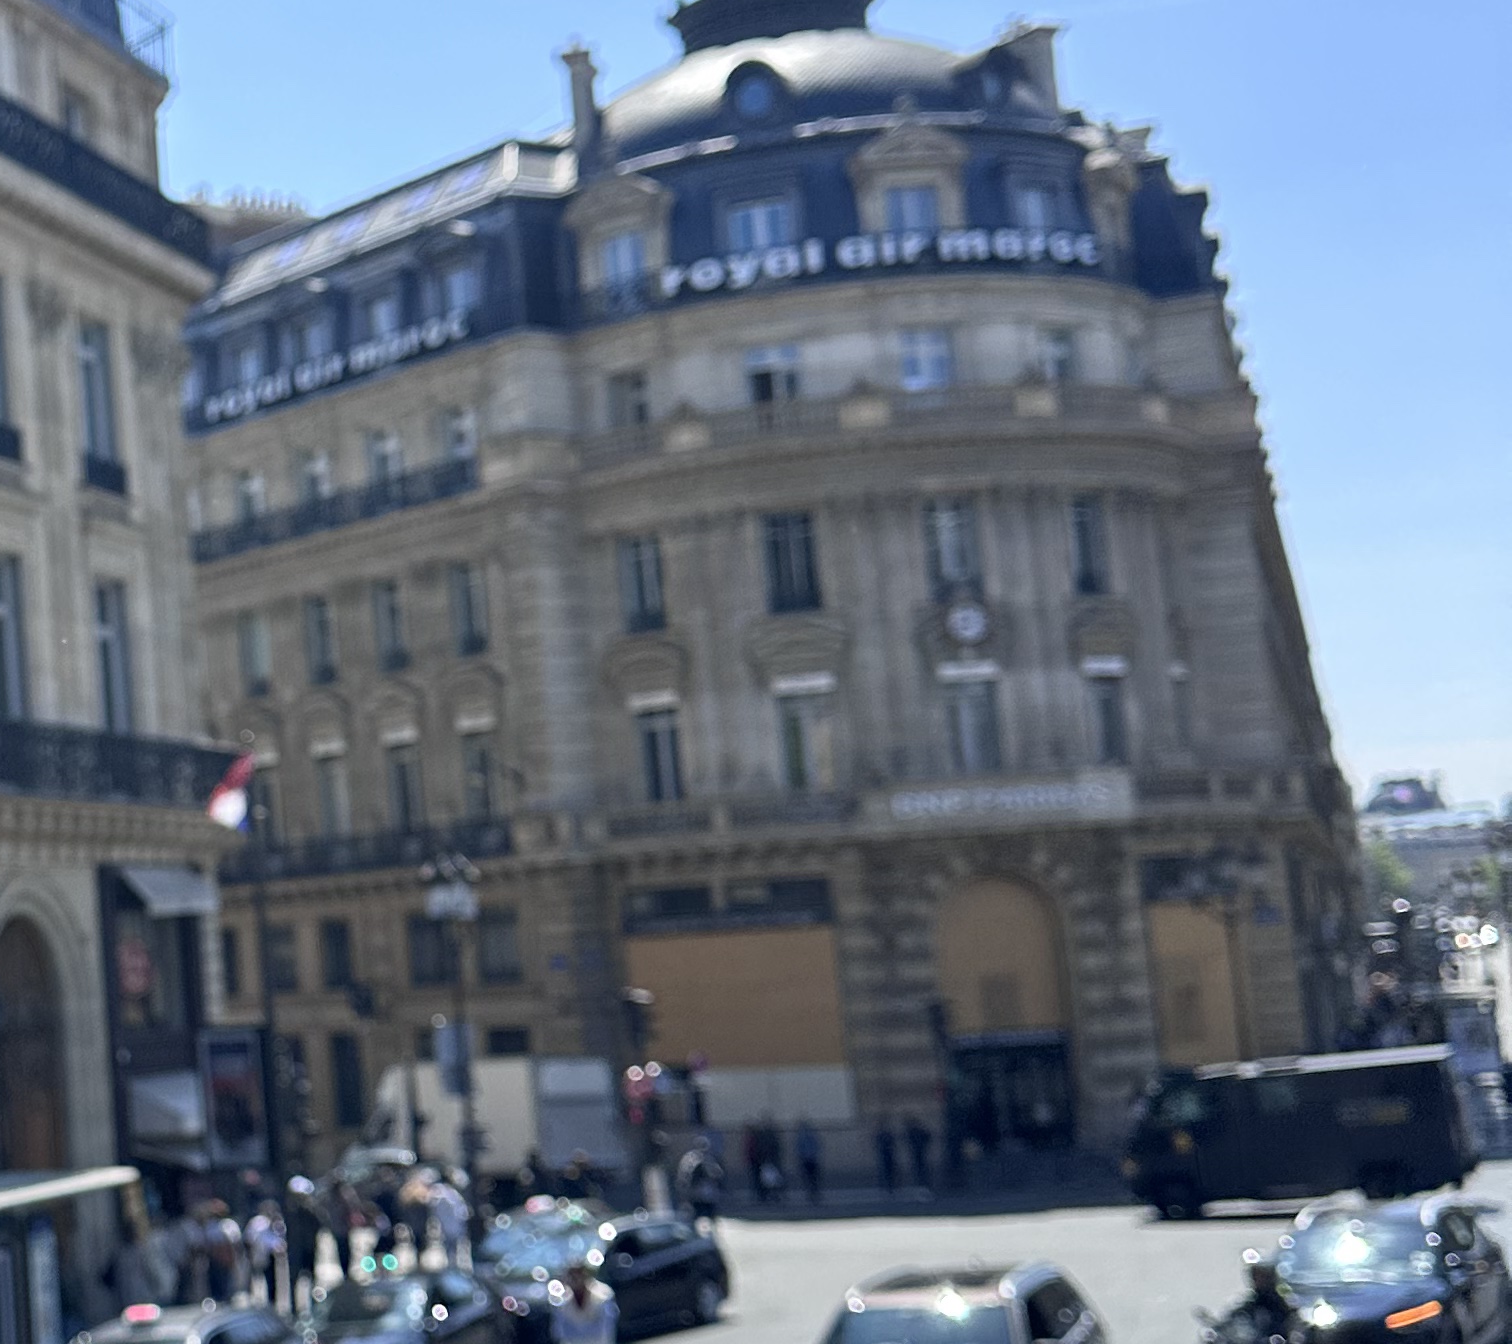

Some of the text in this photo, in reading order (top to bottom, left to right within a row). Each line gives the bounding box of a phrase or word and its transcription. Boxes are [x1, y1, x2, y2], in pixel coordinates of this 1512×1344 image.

[656, 227, 1099, 298] royal air maroc
[203, 310, 469, 424] royal air maroc
